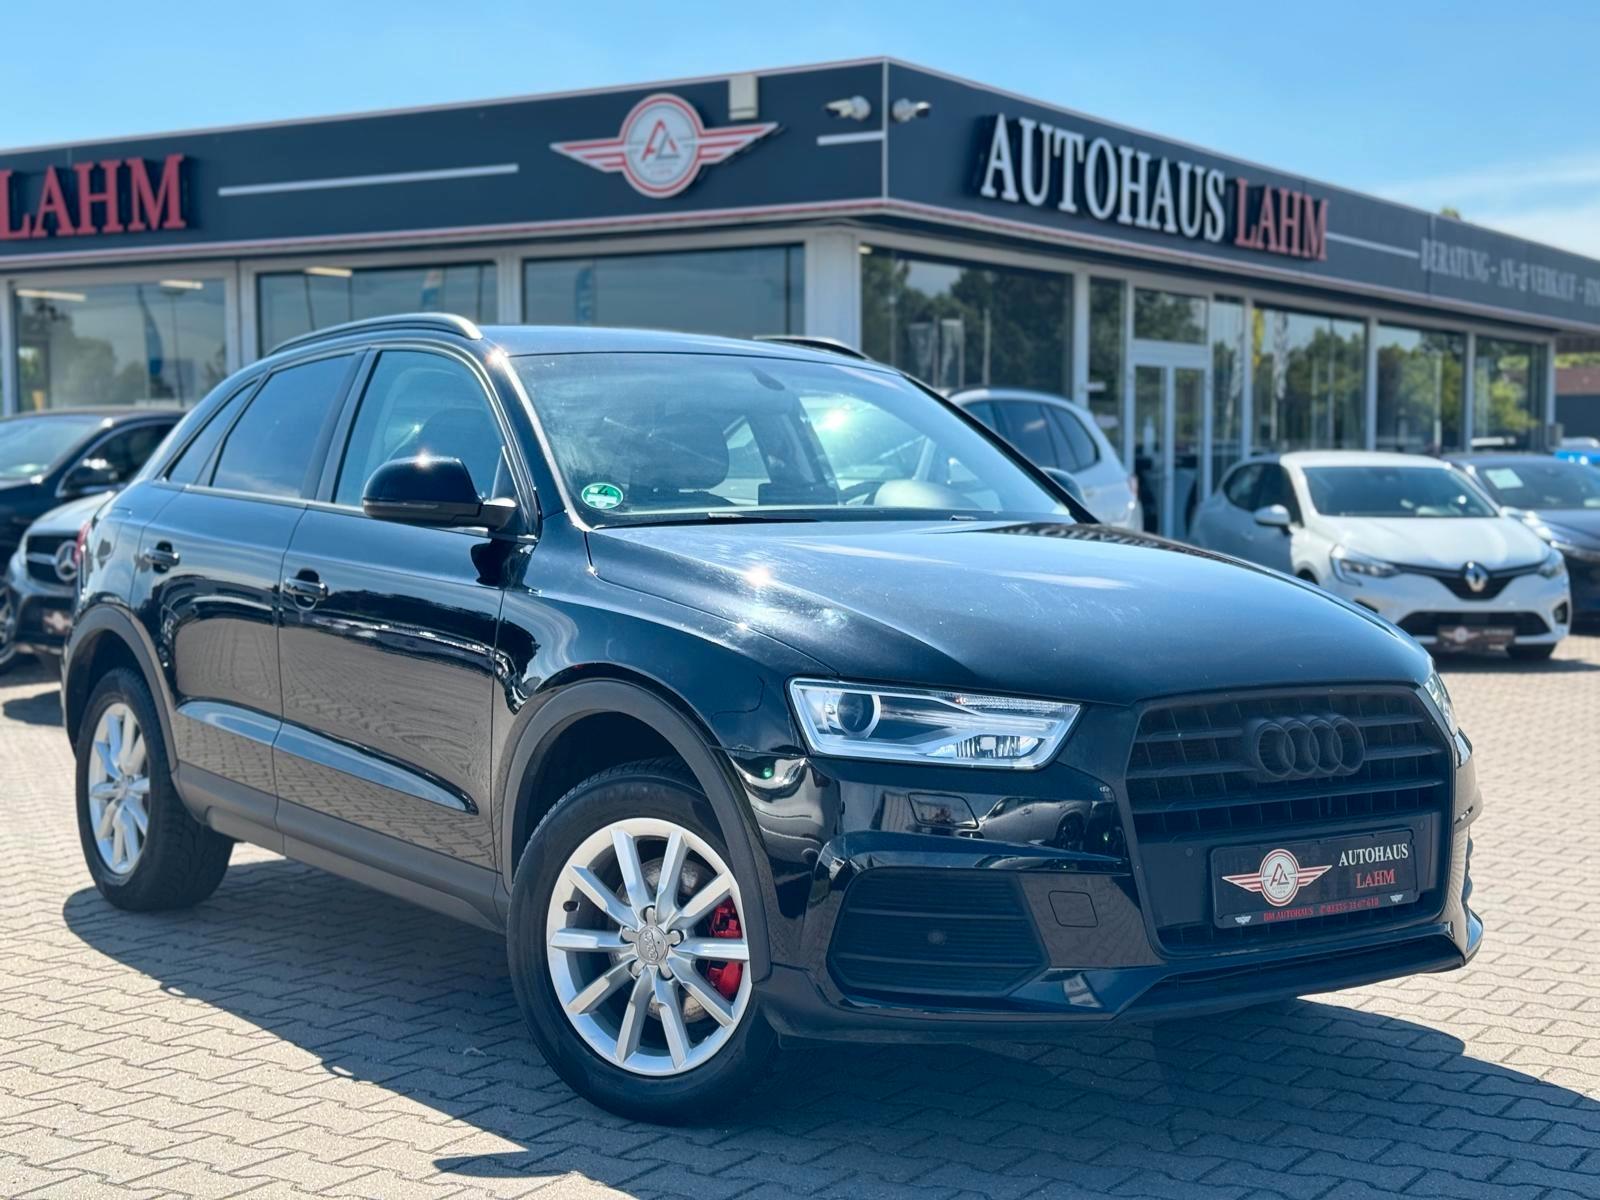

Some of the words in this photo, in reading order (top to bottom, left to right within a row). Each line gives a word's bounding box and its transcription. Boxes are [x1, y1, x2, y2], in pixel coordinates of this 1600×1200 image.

[0, 152, 187, 240] LAHM
[980, 112, 1226, 243] AUTOHAUS
[1234, 176, 1330, 262] LAHM
[1338, 843, 1409, 867] AUTOHAUS
[1355, 868, 1396, 889] LAHM
